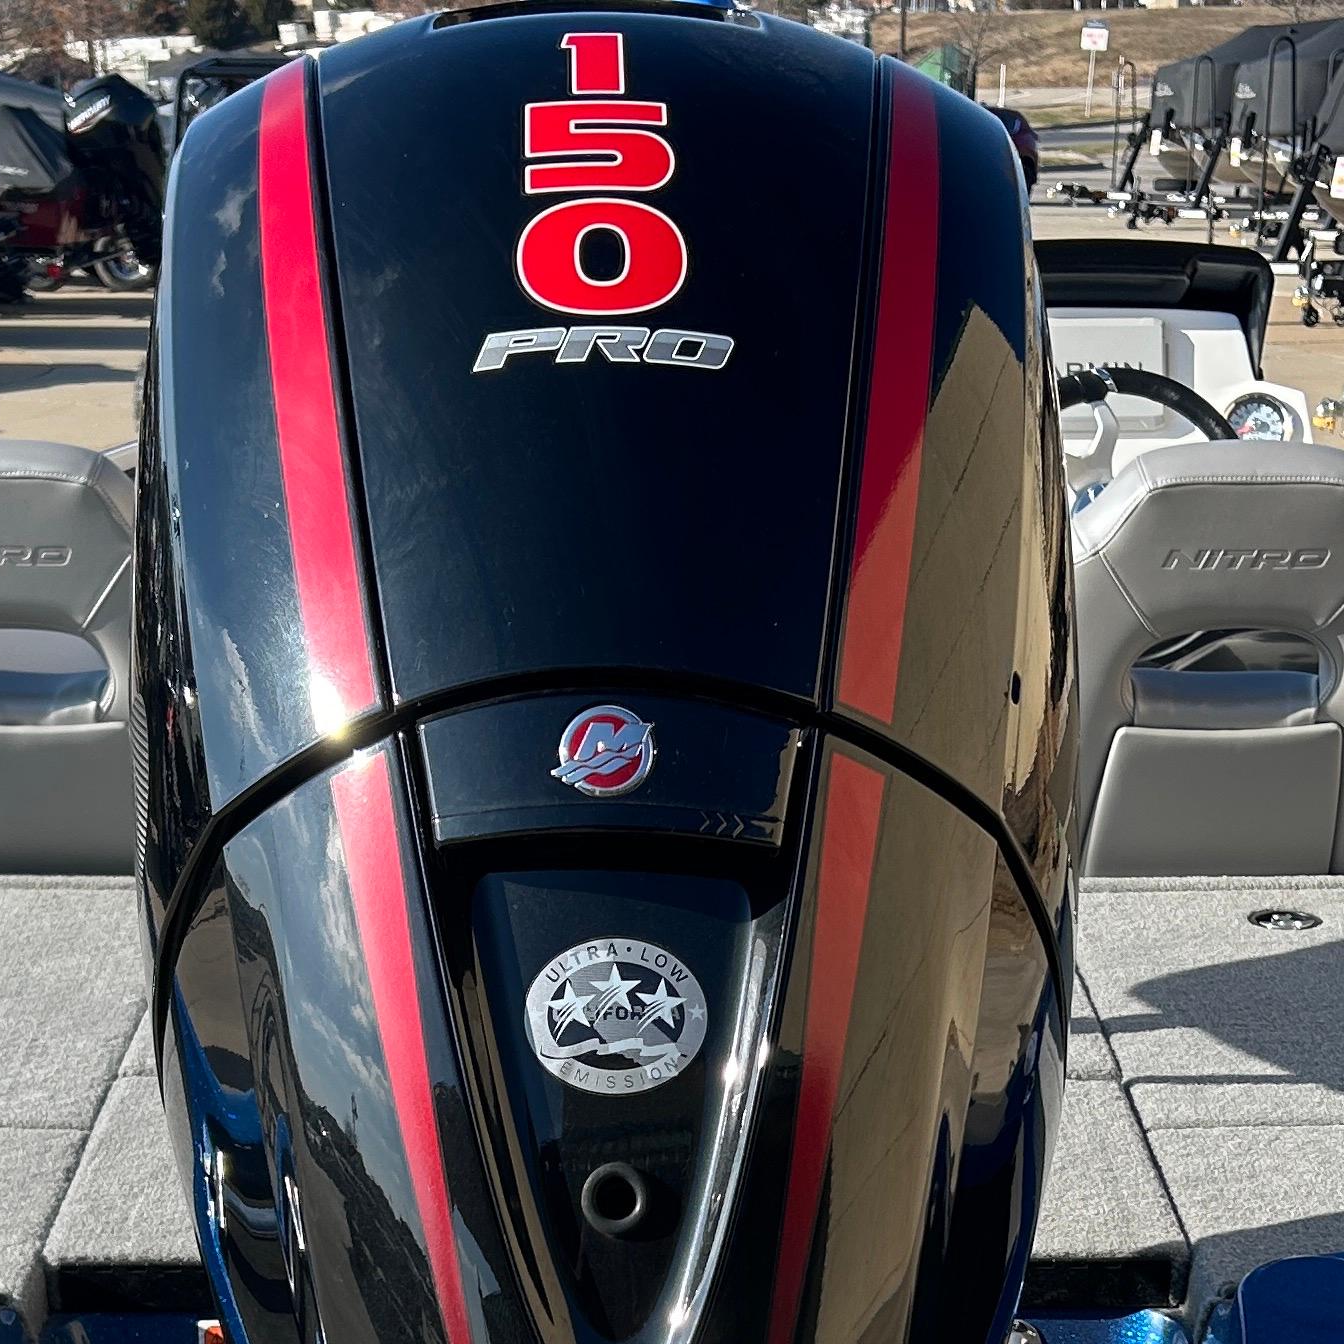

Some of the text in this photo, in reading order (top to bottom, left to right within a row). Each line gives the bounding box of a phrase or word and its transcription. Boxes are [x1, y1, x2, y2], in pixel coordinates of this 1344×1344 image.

[516, 32, 687, 315] 150
[471, 324, 736, 374] PRO
[1161, 549, 1332, 571] NITRO
[545, 942, 689, 984] ULTRA LOW
